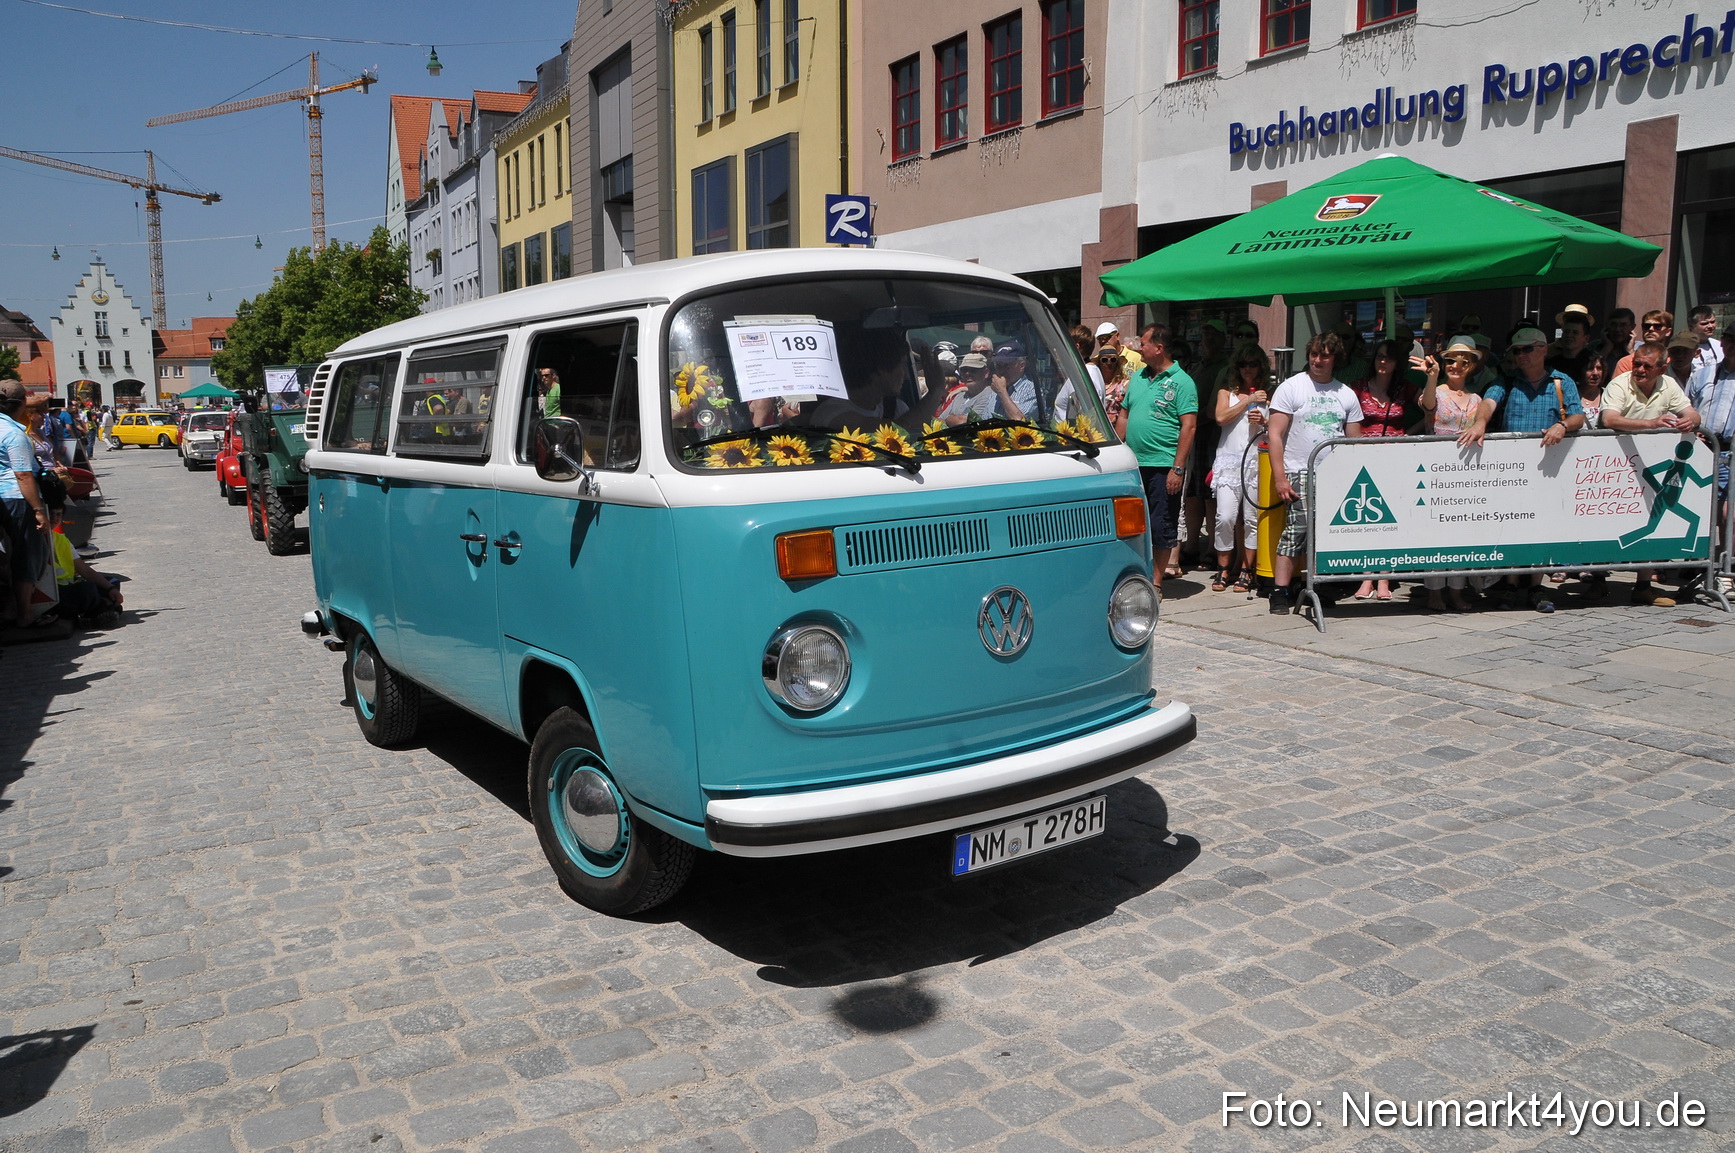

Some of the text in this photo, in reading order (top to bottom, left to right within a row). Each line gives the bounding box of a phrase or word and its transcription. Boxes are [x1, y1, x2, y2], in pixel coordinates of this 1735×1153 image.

[1229, 9, 1735, 155] Buchhandlung Rupprecht
[1262, 222, 1398, 240] Neumarkter
[1227, 229, 1414, 255] Lammsbräu
[782, 336, 818, 351] 189
[1430, 461, 1525, 473] Gebäudereinigung
[1605, 454, 1639, 468] UNS
[1430, 477, 1529, 490] Hausmeisterdienste
[1430, 495, 1488, 507] Mietservice
[1574, 501, 1642, 516] BESSER.
[1439, 510, 1536, 524] Event-Leit-Systeme
[1340, 526, 1363, 534] Gebäude
[1327, 550, 1505, 569] www.jura-gebaeudeservice.de
[958, 800, 1105, 868] D NM T 278H
